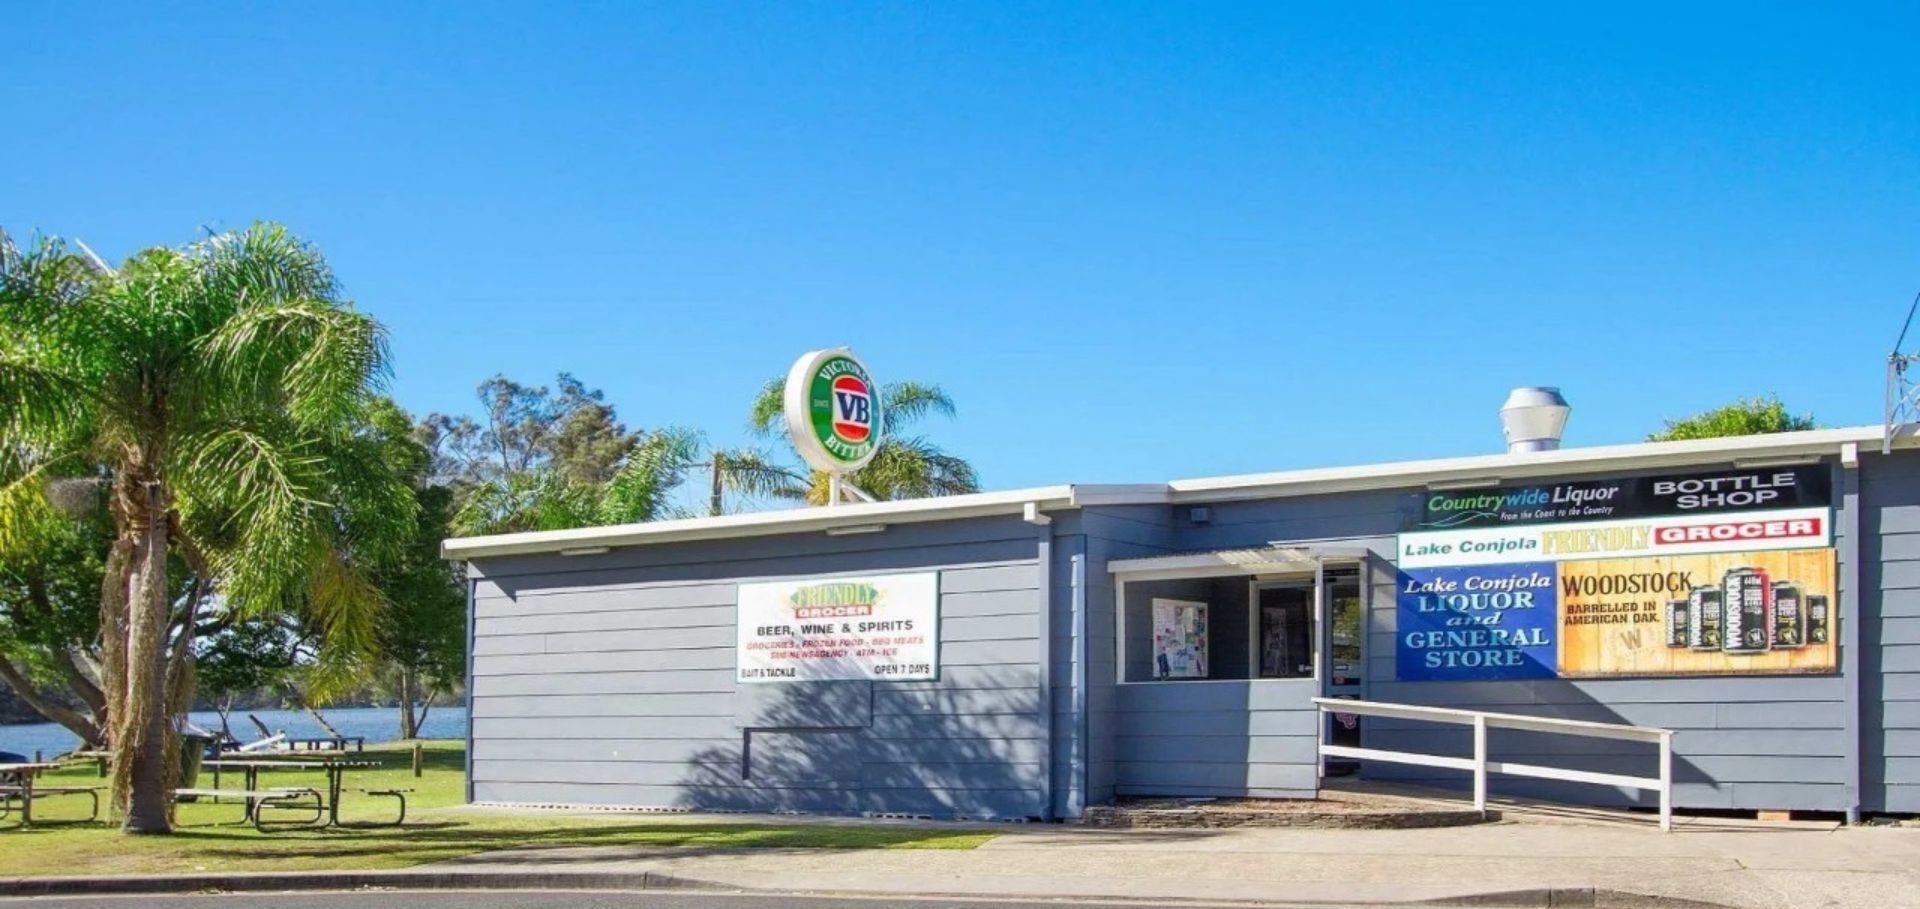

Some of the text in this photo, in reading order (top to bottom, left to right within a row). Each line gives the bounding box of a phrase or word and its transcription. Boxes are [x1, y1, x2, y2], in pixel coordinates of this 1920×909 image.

[820, 360, 871, 390] VICTO
[835, 391, 870, 424] VB
[1653, 472, 1796, 496] BOTTLE
[1427, 486, 1620, 513] Countrywide Liquor
[1676, 489, 1779, 509] SHOP
[1534, 509, 1555, 519] Coast
[1558, 508, 1567, 517] to
[1583, 505, 1613, 516] Country
[1405, 519, 1814, 556] Lake Conjola FRIENDLY GROCER
[1404, 572, 1551, 593] Lake Conjola
[1561, 571, 1692, 597] WOODSTOCK
[798, 583, 873, 617] FRIENDLY GROCER
[1419, 592, 1535, 612] LIQUOR
[1567, 601, 1656, 614] BARRELLED IN
[757, 620, 913, 637] BEER, WINE & SPIRITS
[1446, 611, 1502, 626] and
[1564, 614, 1628, 625] AMERICAN
[1405, 628, 1550, 648] GENERAL
[874, 663, 930, 674] OPEN 7 DAYS
[1425, 649, 1524, 668] STORE
[741, 668, 758, 678] BAIT
[767, 667, 796, 677] TACKLE
